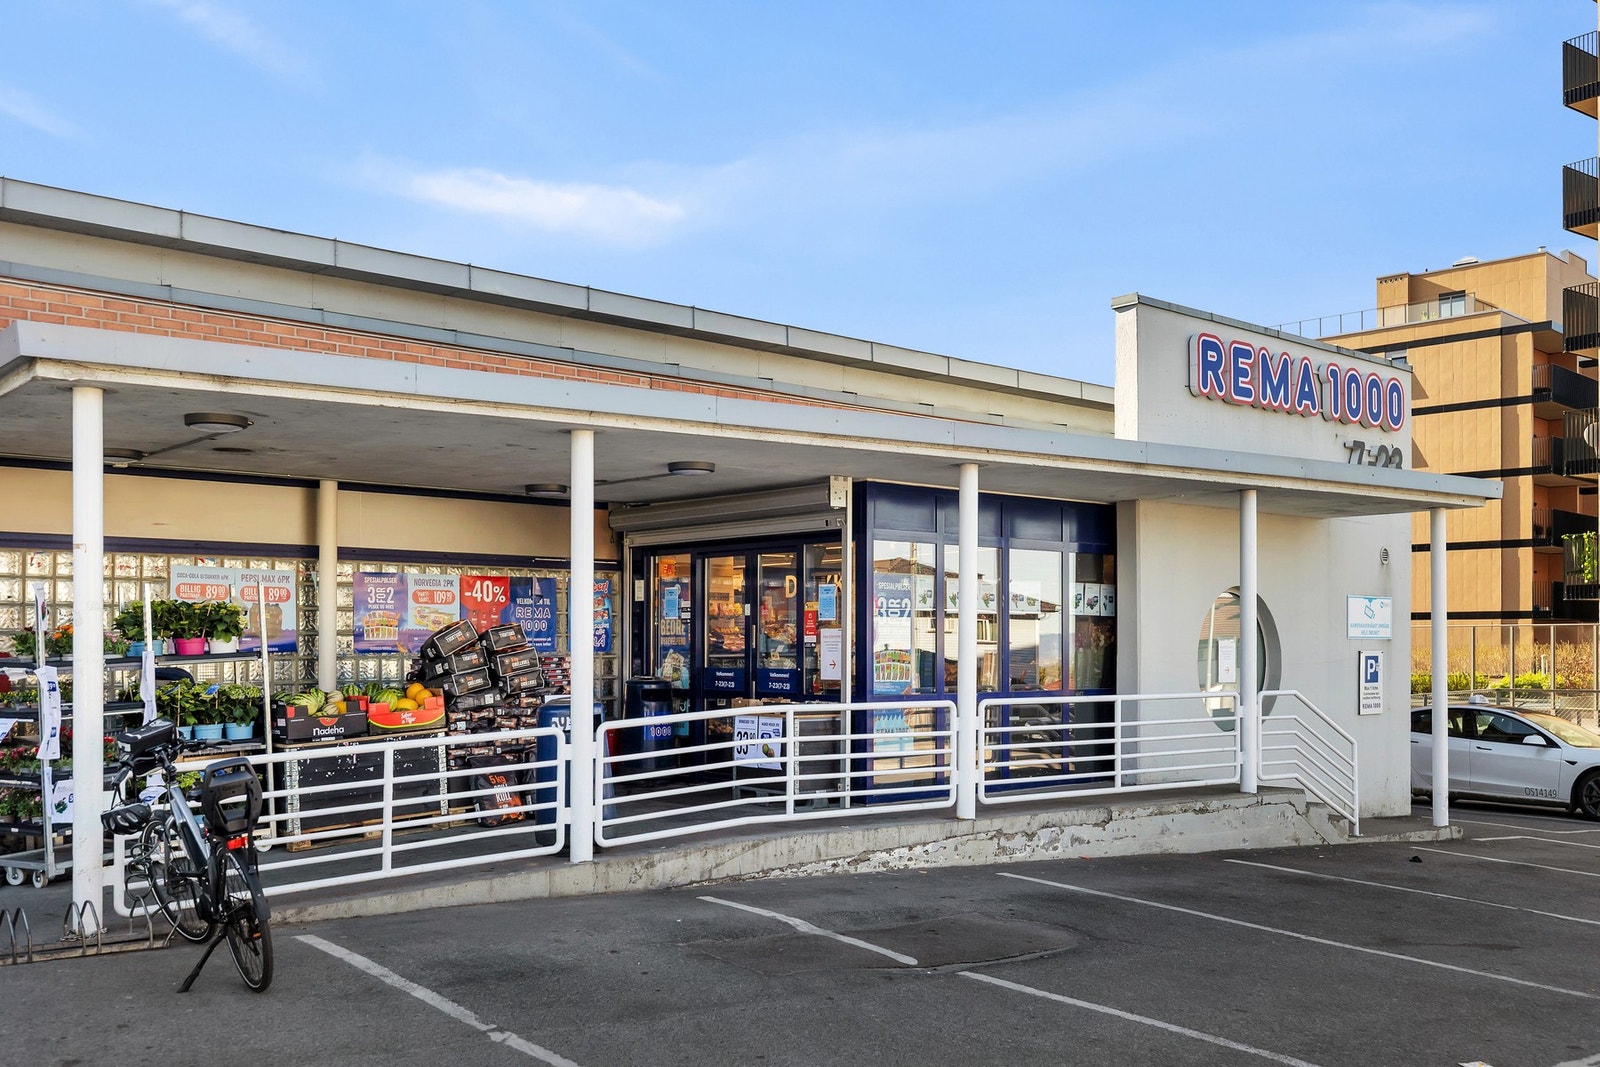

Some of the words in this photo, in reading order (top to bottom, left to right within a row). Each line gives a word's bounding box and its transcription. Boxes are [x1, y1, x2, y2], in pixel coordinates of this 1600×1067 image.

[1197, 332, 1320, 417] REMA
[1326, 362, 1405, 432] 1000
[261, 575, 276, 583] MAX
[413, 578, 441, 587] NORVEGIA
[443, 579, 455, 587] 2PK
[179, 584, 202, 593] BILLIG
[367, 586, 376, 604] 3
[376, 587, 386, 604] FOR
[386, 587, 395, 604] 2
[464, 580, 506, 603] -40%
[515, 606, 551, 619] REMA
[520, 619, 548, 632] 1000
[1367, 659, 1376, 680] P
[495, 791, 513, 803] KULL
[1524, 787, 1557, 798] OS14149
